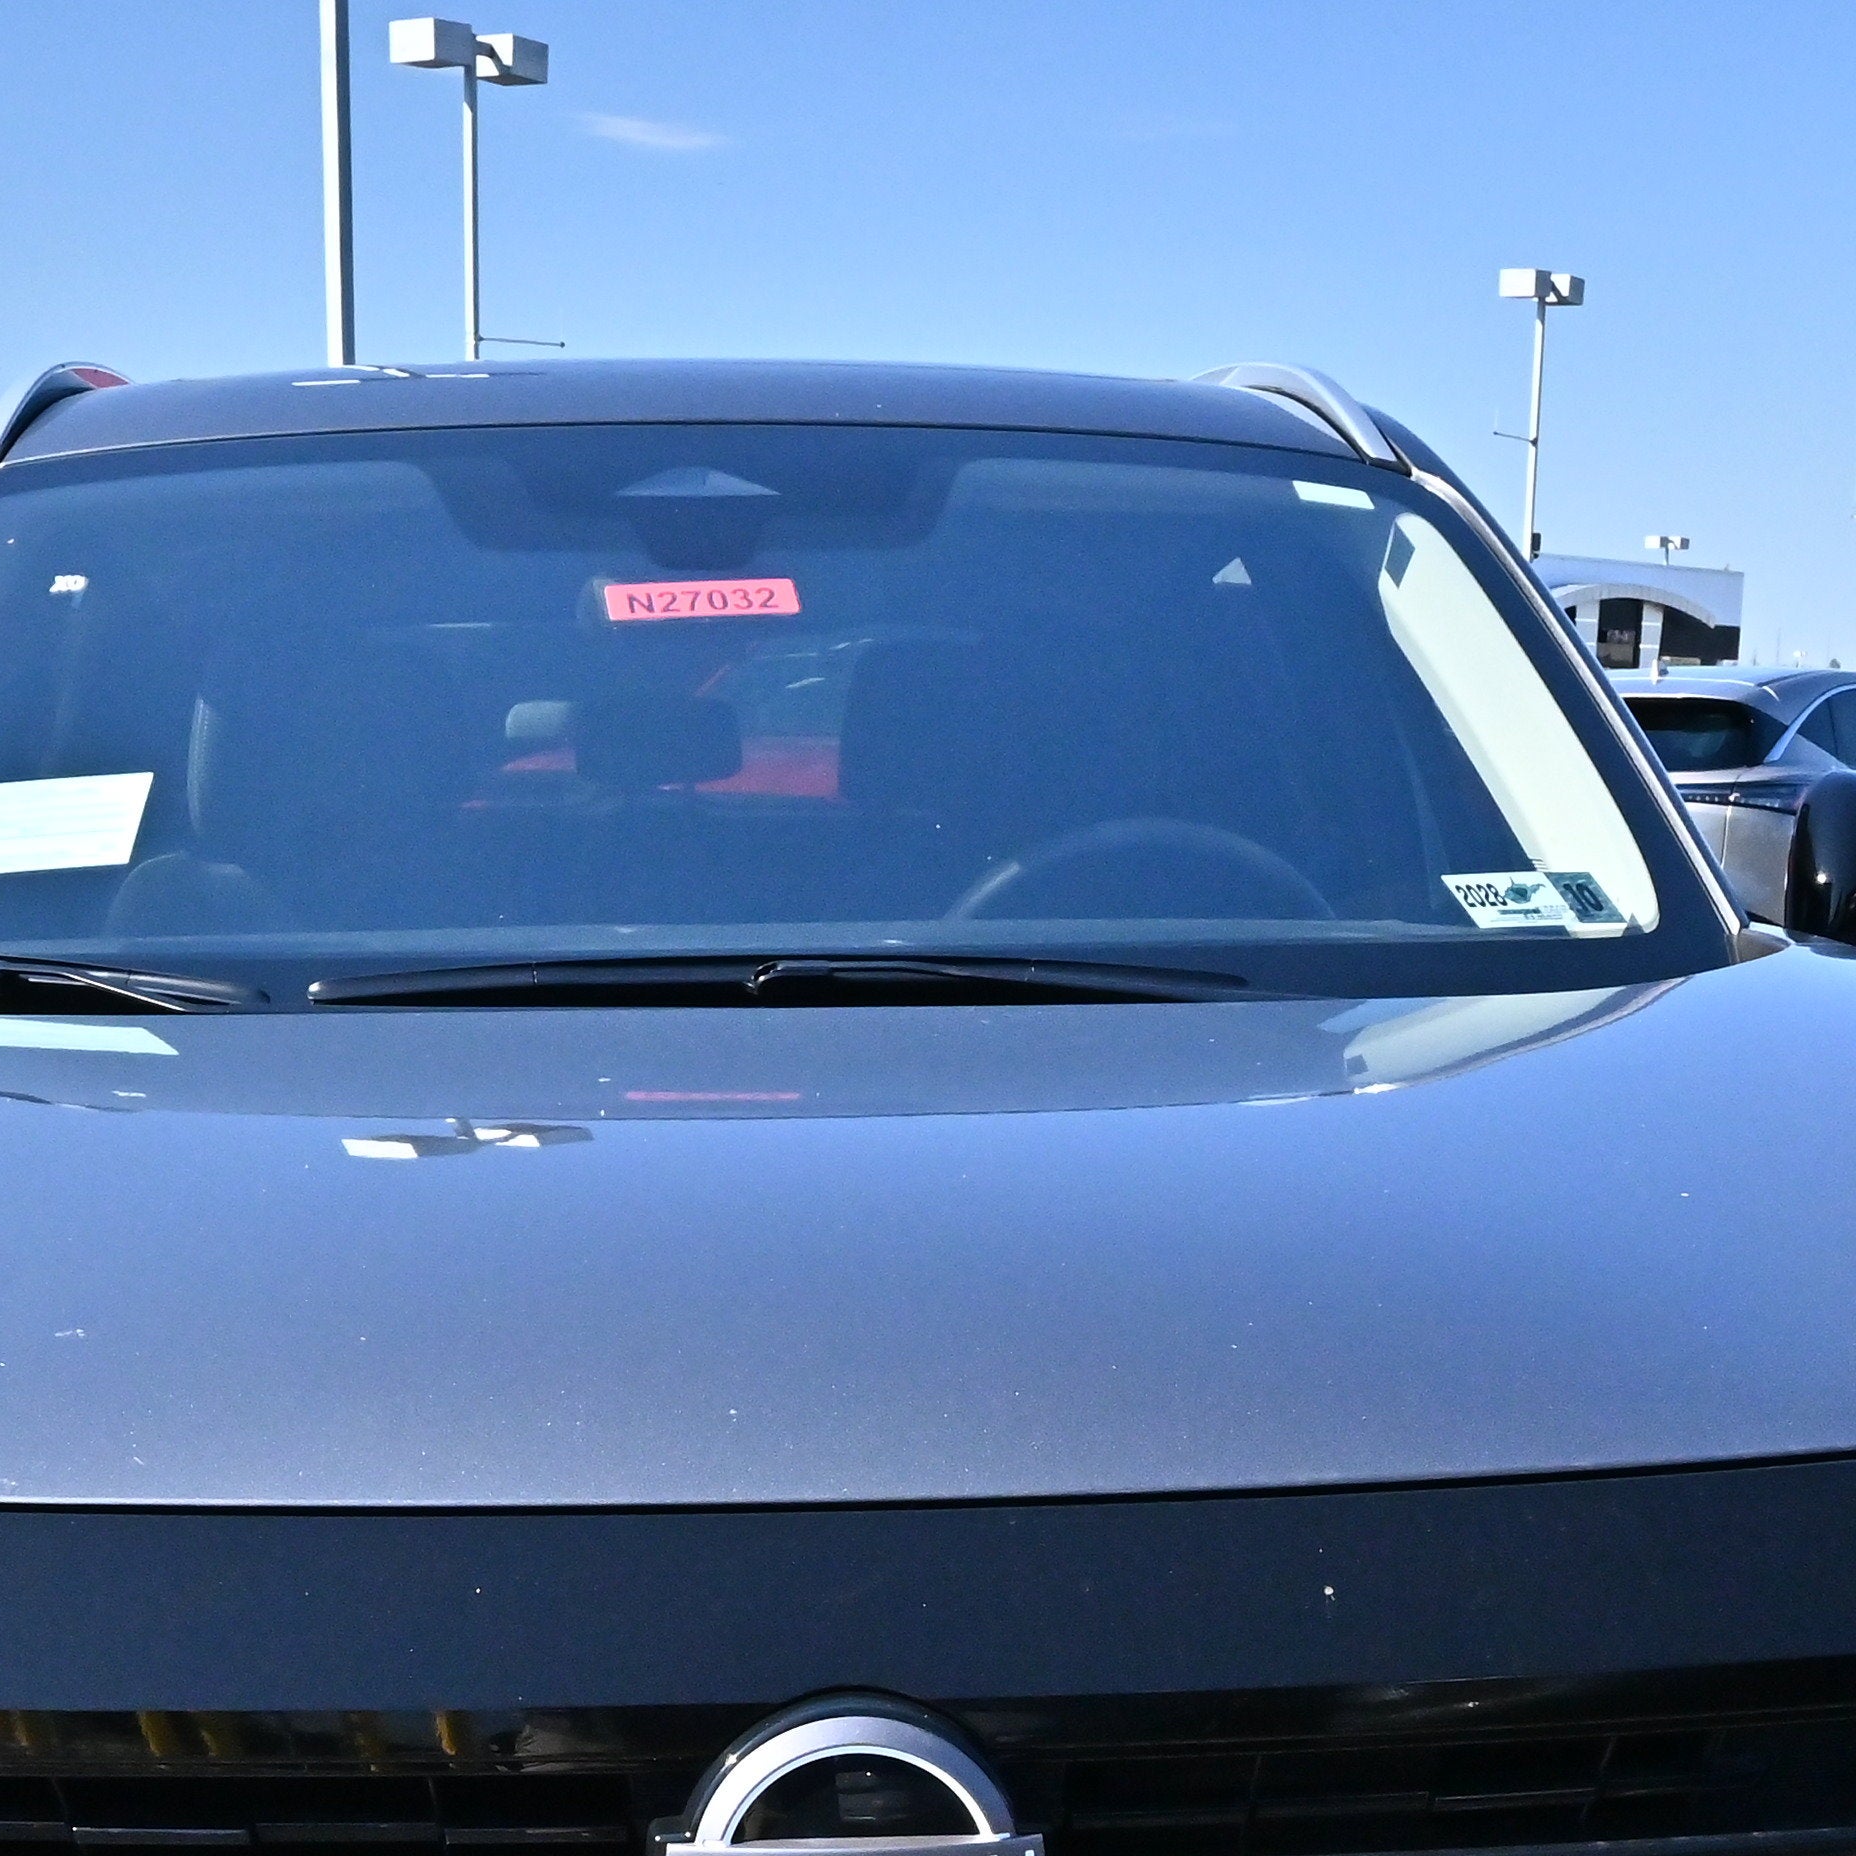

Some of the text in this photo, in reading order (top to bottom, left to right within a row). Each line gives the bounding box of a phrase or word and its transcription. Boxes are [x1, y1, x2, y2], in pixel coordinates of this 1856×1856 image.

[626, 586, 779, 614] N27032
[1455, 883, 1508, 908] 2028
[1562, 882, 1604, 915] 10
